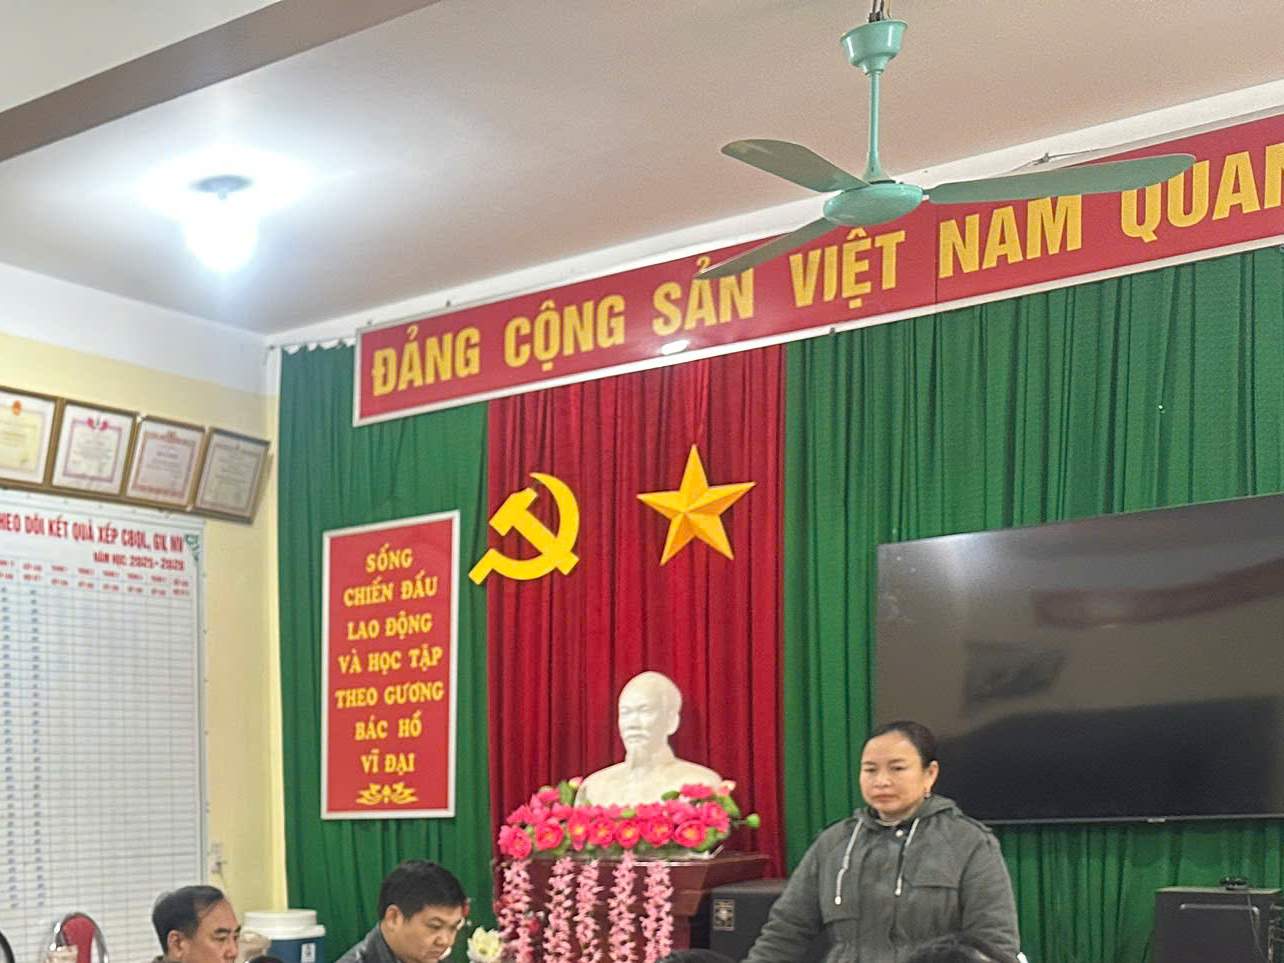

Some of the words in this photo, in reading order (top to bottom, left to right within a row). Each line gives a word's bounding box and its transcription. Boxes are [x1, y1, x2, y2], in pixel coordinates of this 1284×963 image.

[372, 325, 480, 397] ĐẢNG
[504, 299, 625, 370] CỘNG
[652, 256, 754, 336] SẢN
[789, 227, 906, 309] VIỆT
[938, 194, 1082, 279] NAM
[48, 515, 69, 538] KẾT
[366, 543, 413, 573] SỐNG
[343, 575, 393, 608] CHIẾN
[401, 569, 438, 600] ĐẤU
[347, 620, 380, 641] LAO
[385, 611, 432, 639] ĐỘNG
[338, 649, 362, 674] VÀ
[368, 651, 402, 675] HỌC
[408, 644, 443, 671] TẬP
[335, 687, 378, 709] THEO
[384, 681, 444, 705] GƯƠNG
[354, 715, 388, 741] BÁC
[360, 748, 379, 774] VĨ
[384, 752, 415, 776] ĐẠI
